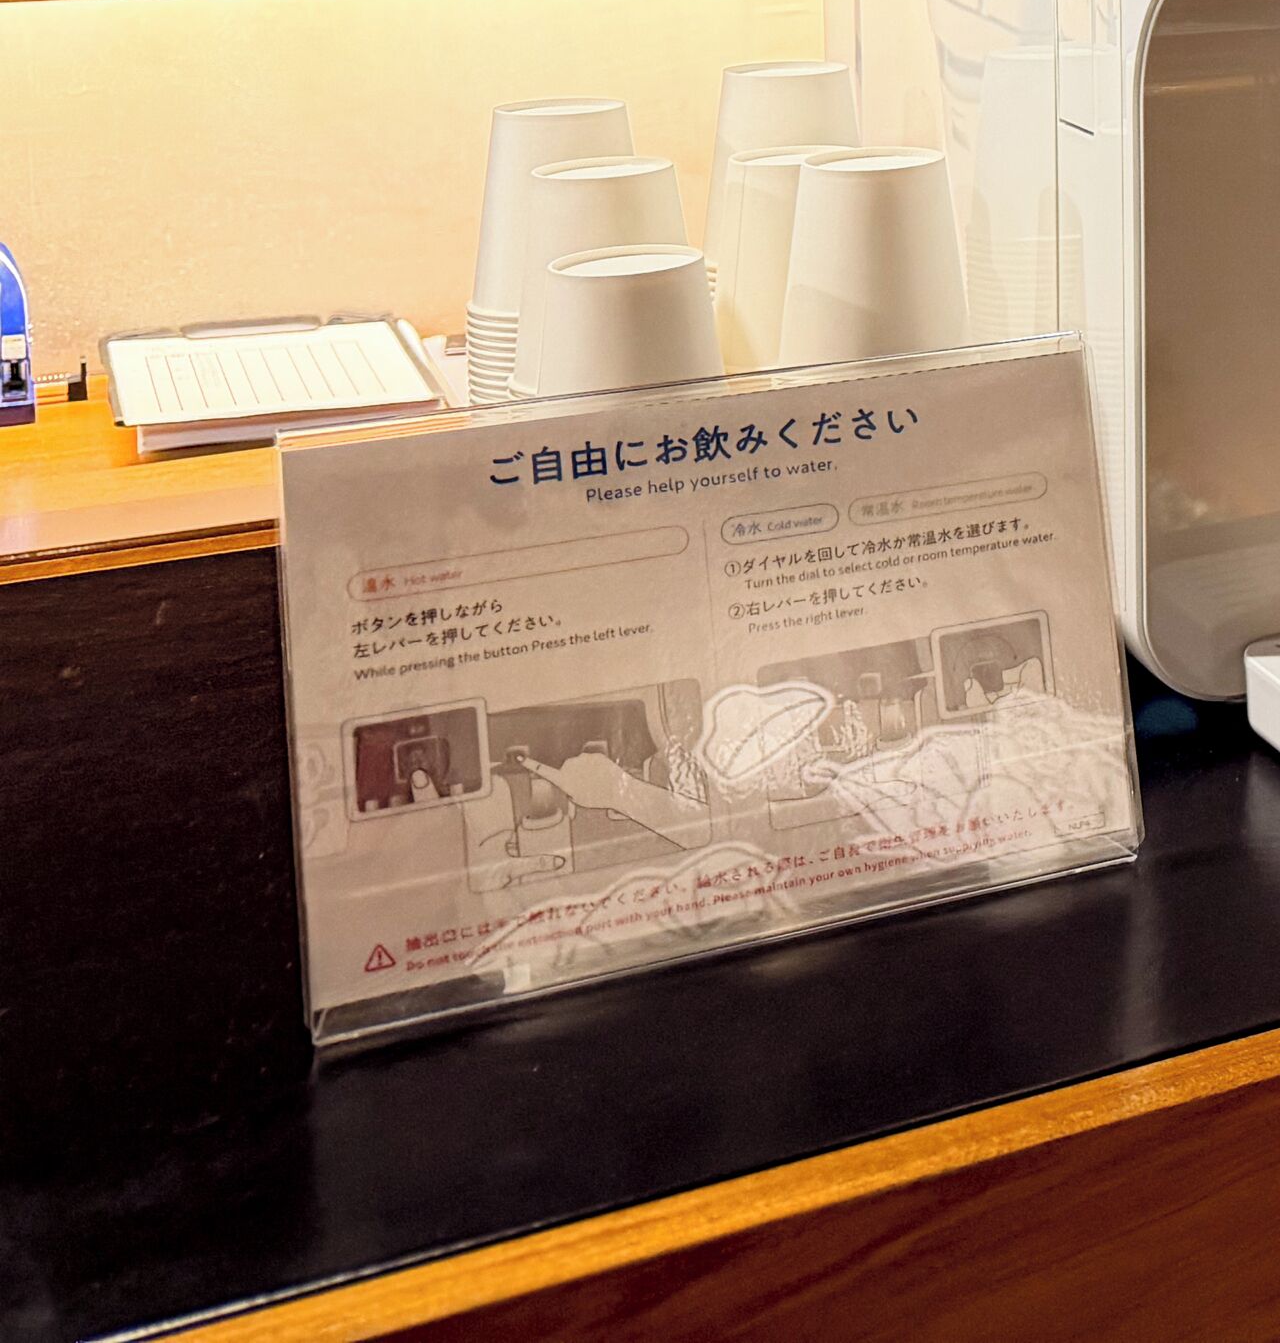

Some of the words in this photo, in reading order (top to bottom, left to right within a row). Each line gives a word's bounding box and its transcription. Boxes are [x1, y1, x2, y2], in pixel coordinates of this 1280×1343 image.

[488, 407, 919, 486] ご自由にお飲みください
[586, 483, 643, 503] Please
[646, 476, 685, 495] help
[690, 466, 760, 492] yourself
[763, 464, 783, 479] to
[786, 457, 838, 475] water.
[723, 516, 1031, 577] ①ダイヤルを回して冷水か常温水を選びます。
[731, 521, 762, 537] 冷水
[766, 519, 793, 532] Cold
[745, 572, 773, 590] Turn
[776, 569, 796, 585] the
[798, 565, 821, 582] dial
[823, 565, 836, 579] to
[838, 559, 872, 576] select
[875, 555, 900, 571] cold
[902, 554, 915, 566] or
[917, 549, 948, 562] room
[950, 536, 1019, 559] temperature
[350, 599, 504, 636] ボタンを押しながら
[728, 575, 930, 620] ②右レバーを押してください。
[352, 612, 564, 660] 左レバーを押してください。
[747, 616, 780, 634] Press
[783, 613, 803, 629] the
[805, 608, 832, 627] right
[353, 660, 397, 682] While
[399, 654, 455, 675] pressing
[457, 649, 480, 664] the
[483, 641, 529, 661] button
[531, 635, 567, 653] Press
[569, 632, 591, 647] the
[593, 626, 616, 643] left
[753, 876, 806, 896] maintain
[808, 871, 834, 887] your
[837, 865, 862, 878] own
[863, 856, 908, 874] hygiene
